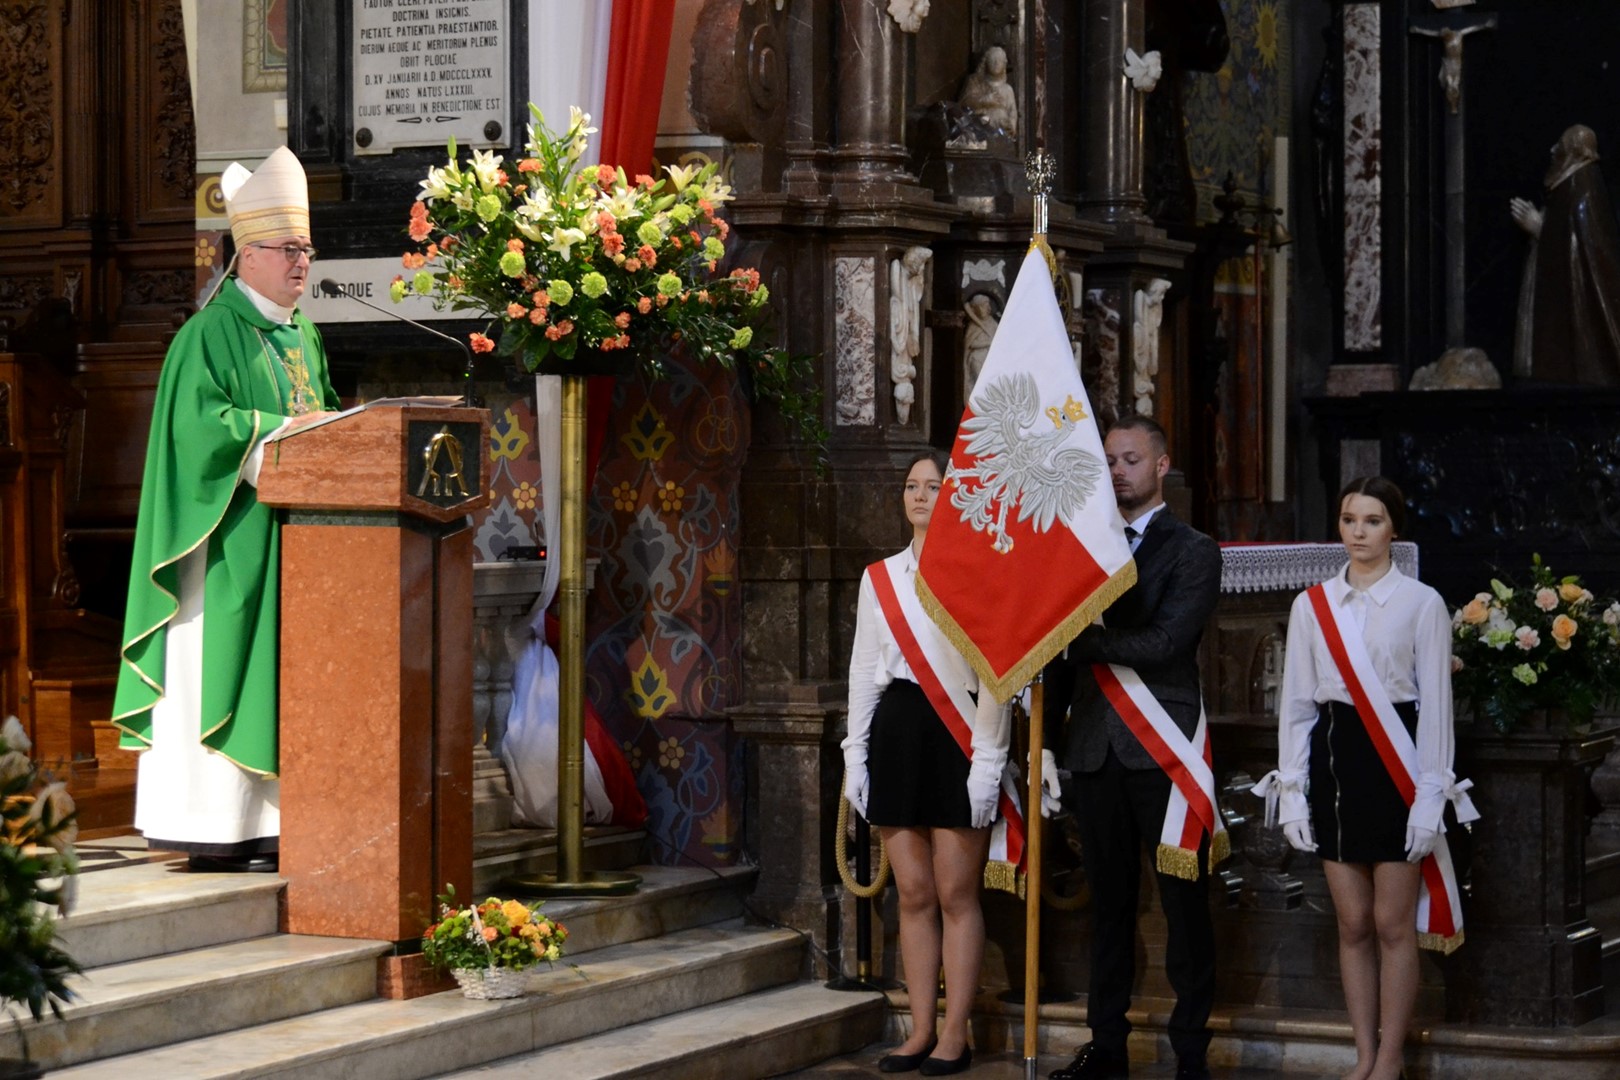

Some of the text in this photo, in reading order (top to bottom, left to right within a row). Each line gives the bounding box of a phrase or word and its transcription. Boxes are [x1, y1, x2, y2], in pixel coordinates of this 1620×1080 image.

[392, 10, 429, 22] DOCTRINA
[396, 24, 436, 37] PATIENTIA
[361, 36, 498, 54] DIERUM AEQUE AC MERITORUM PLENUS
[400, 53, 456, 68] OBIIT PLOCIAE
[374, 74, 383, 85] XV
[387, 71, 421, 84] JANUARII
[386, 88, 410, 99] ANNOS
[417, 86, 442, 98] NATUS
[358, 98, 501, 117] CUJUS MEMORIA IN BENEDICTIONE EST
